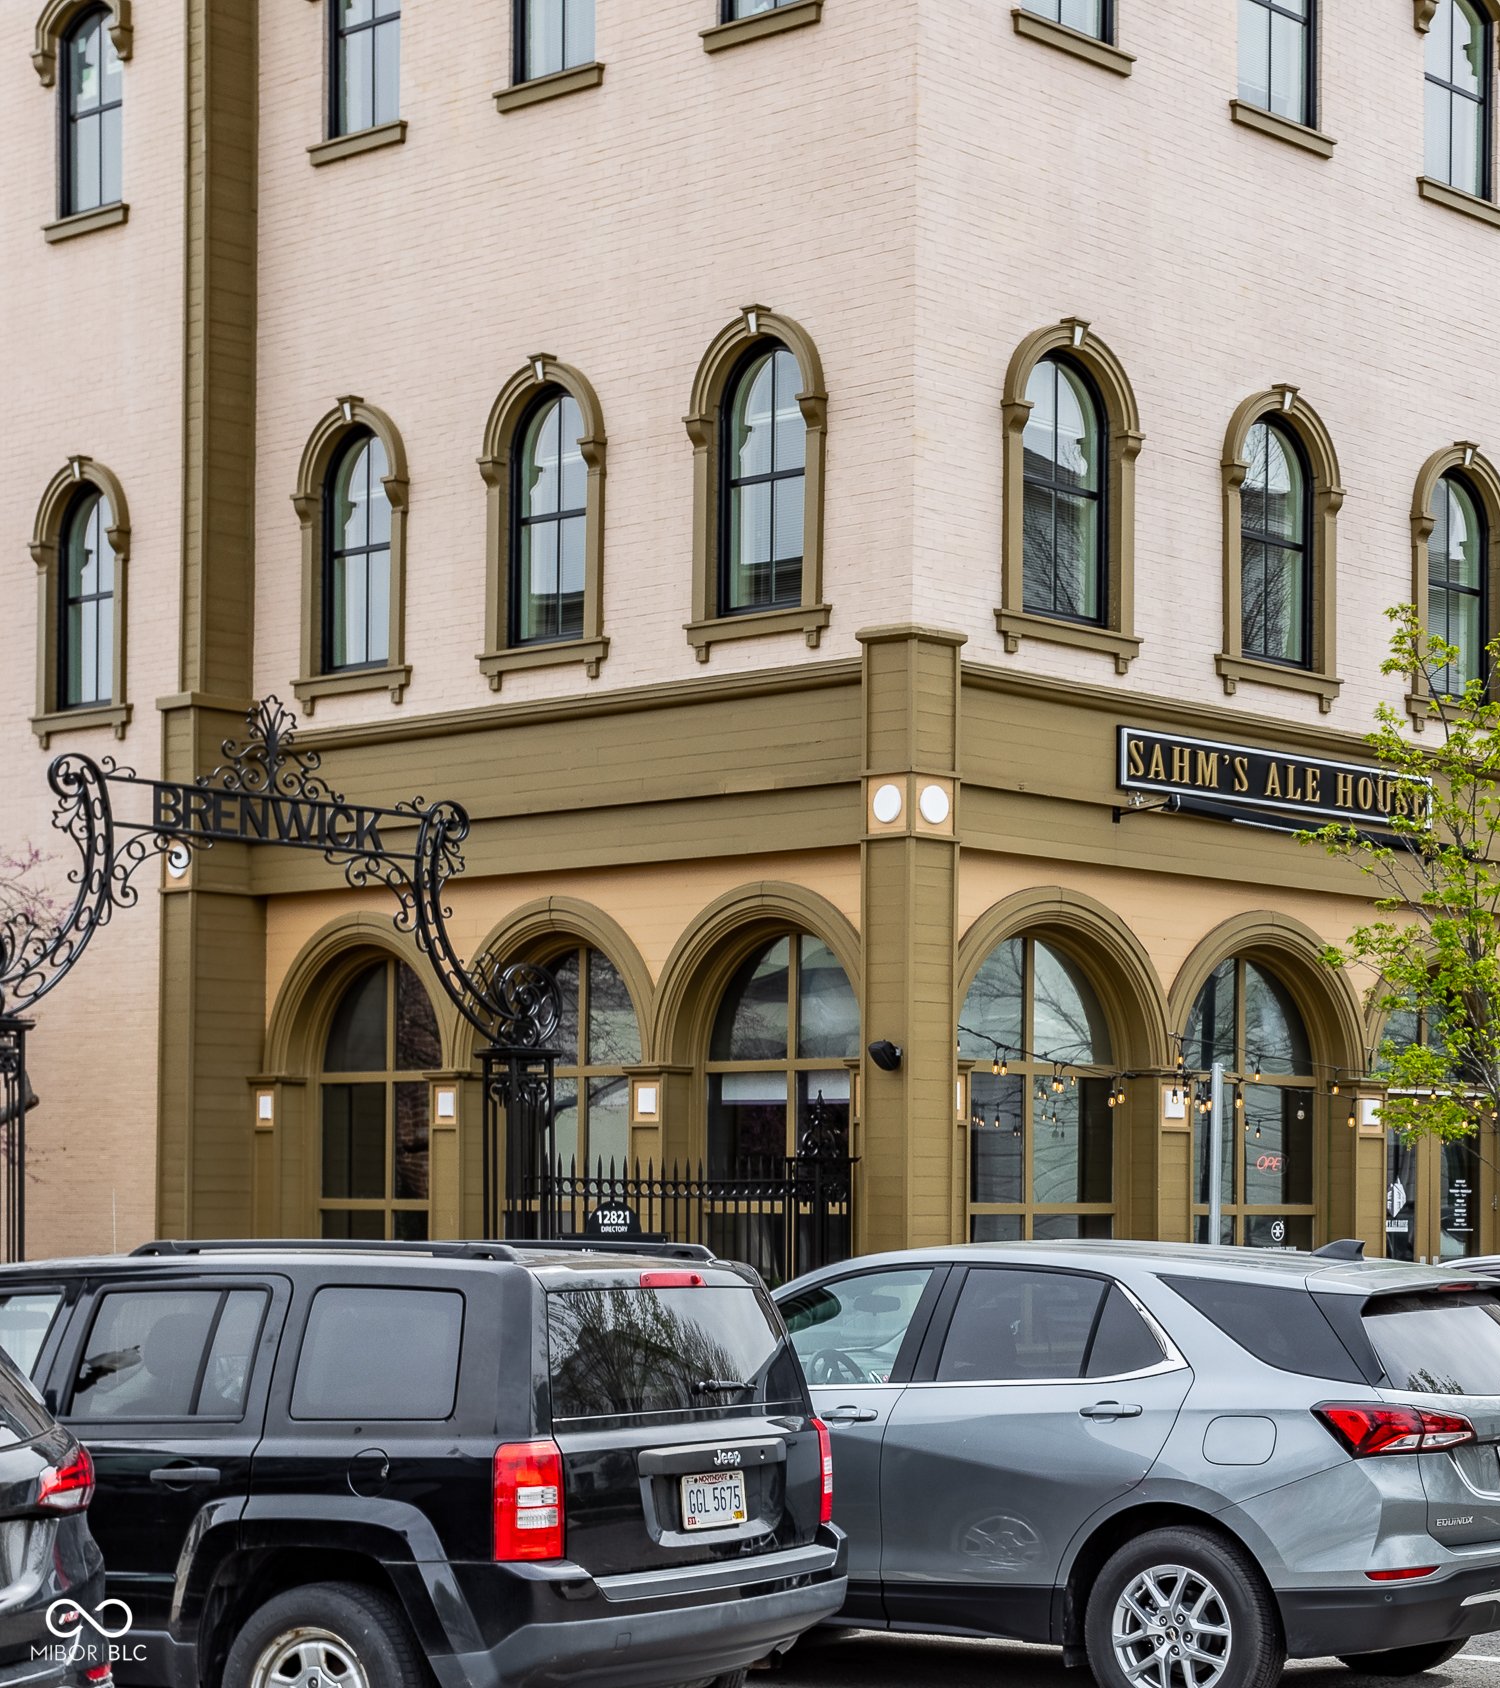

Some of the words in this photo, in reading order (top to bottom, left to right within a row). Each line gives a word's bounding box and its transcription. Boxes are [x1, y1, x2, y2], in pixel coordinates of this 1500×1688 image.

[1129, 740, 1249, 792] SAHM'S
[1265, 761, 1322, 802] ALE
[1335, 773, 1428, 818] HOUSE
[153, 783, 384, 853] BRENWICK
[597, 1210, 630, 1224] 12821
[601, 1225, 628, 1233] DIRECTORY
[713, 1449, 741, 1466] Jeep
[699, 1473, 728, 1483] NORTHGATE
[689, 1489, 710, 1514] GGL
[713, 1485, 741, 1511] 5675
[1436, 1515, 1474, 1527] EQUINOX
